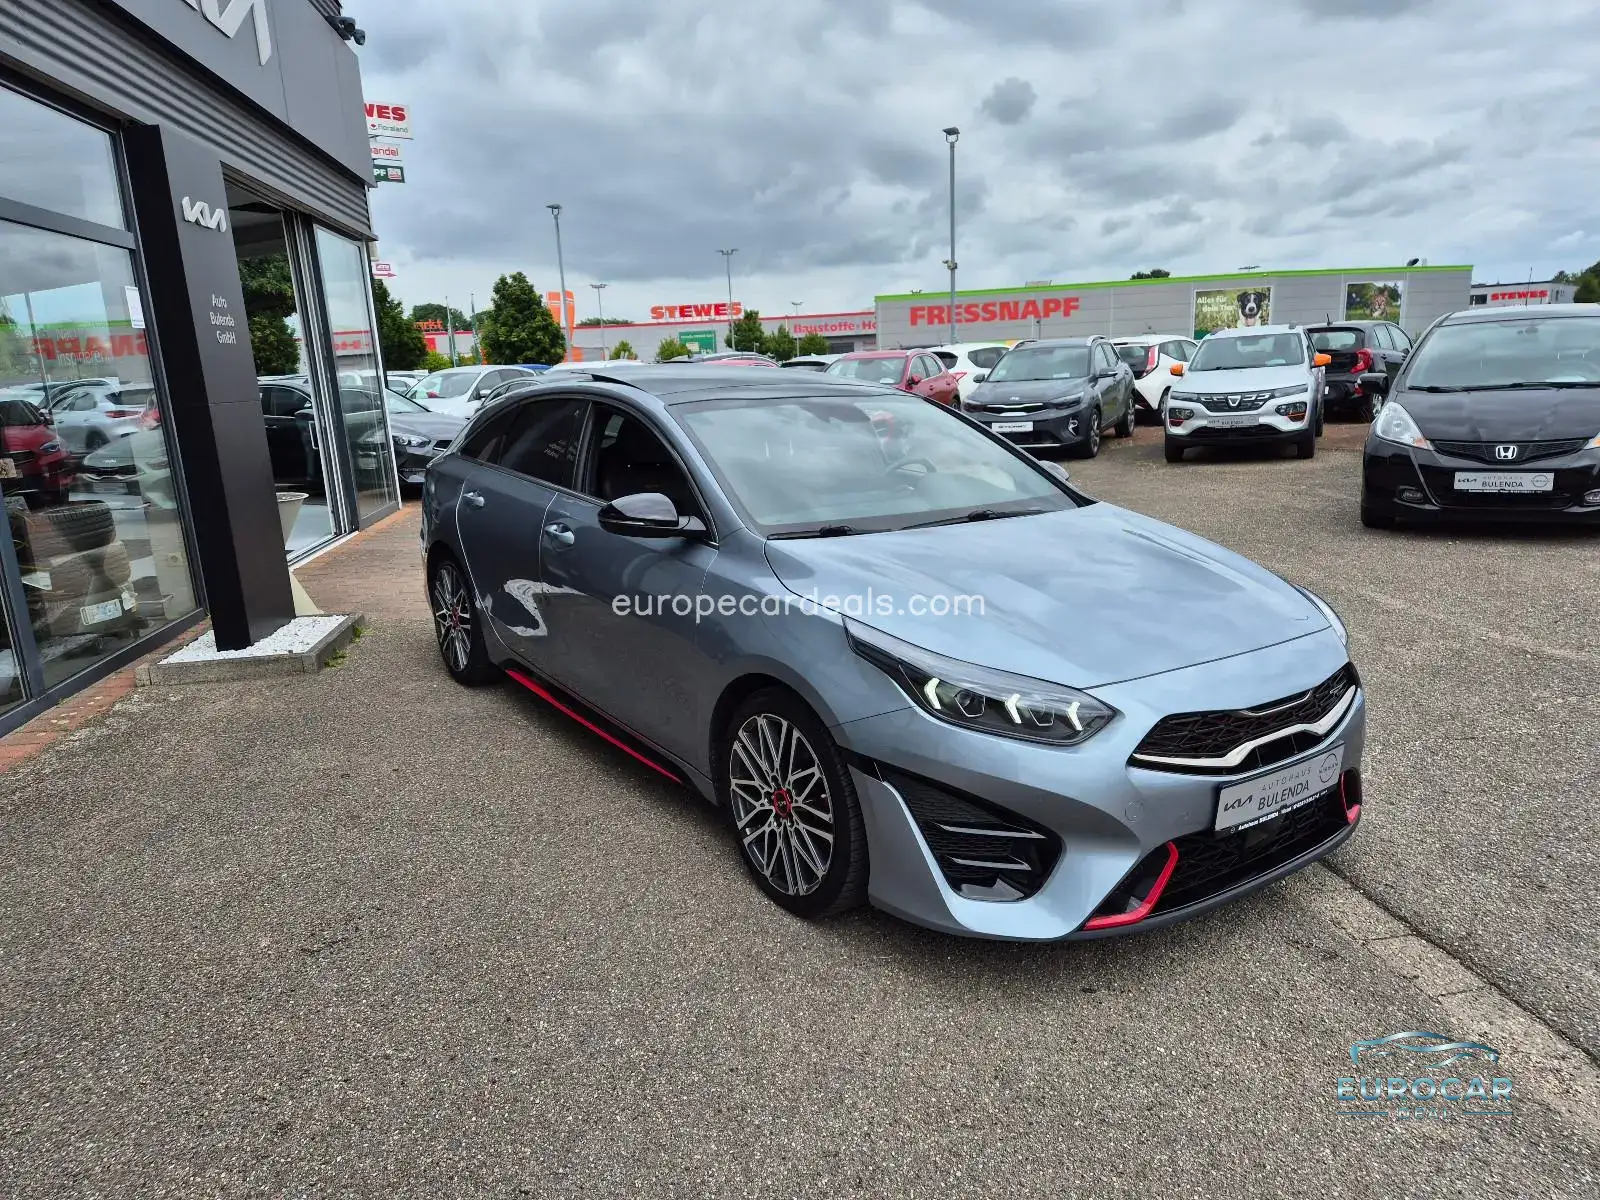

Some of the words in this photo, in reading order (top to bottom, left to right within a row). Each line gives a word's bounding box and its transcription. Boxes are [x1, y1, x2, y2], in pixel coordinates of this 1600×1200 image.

[212, 294, 227, 308] Auto
[1491, 290, 1548, 301] STEWES
[650, 301, 743, 320] STEWES
[909, 297, 1081, 327] FRESSNAPF
[210, 311, 235, 326] Bulenda
[793, 321, 856, 334] Baustoffe
[216, 331, 236, 345] GmbH
[1261, 766, 1312, 791] AUTOHAUS
[1258, 779, 1310, 811] BULENDA
